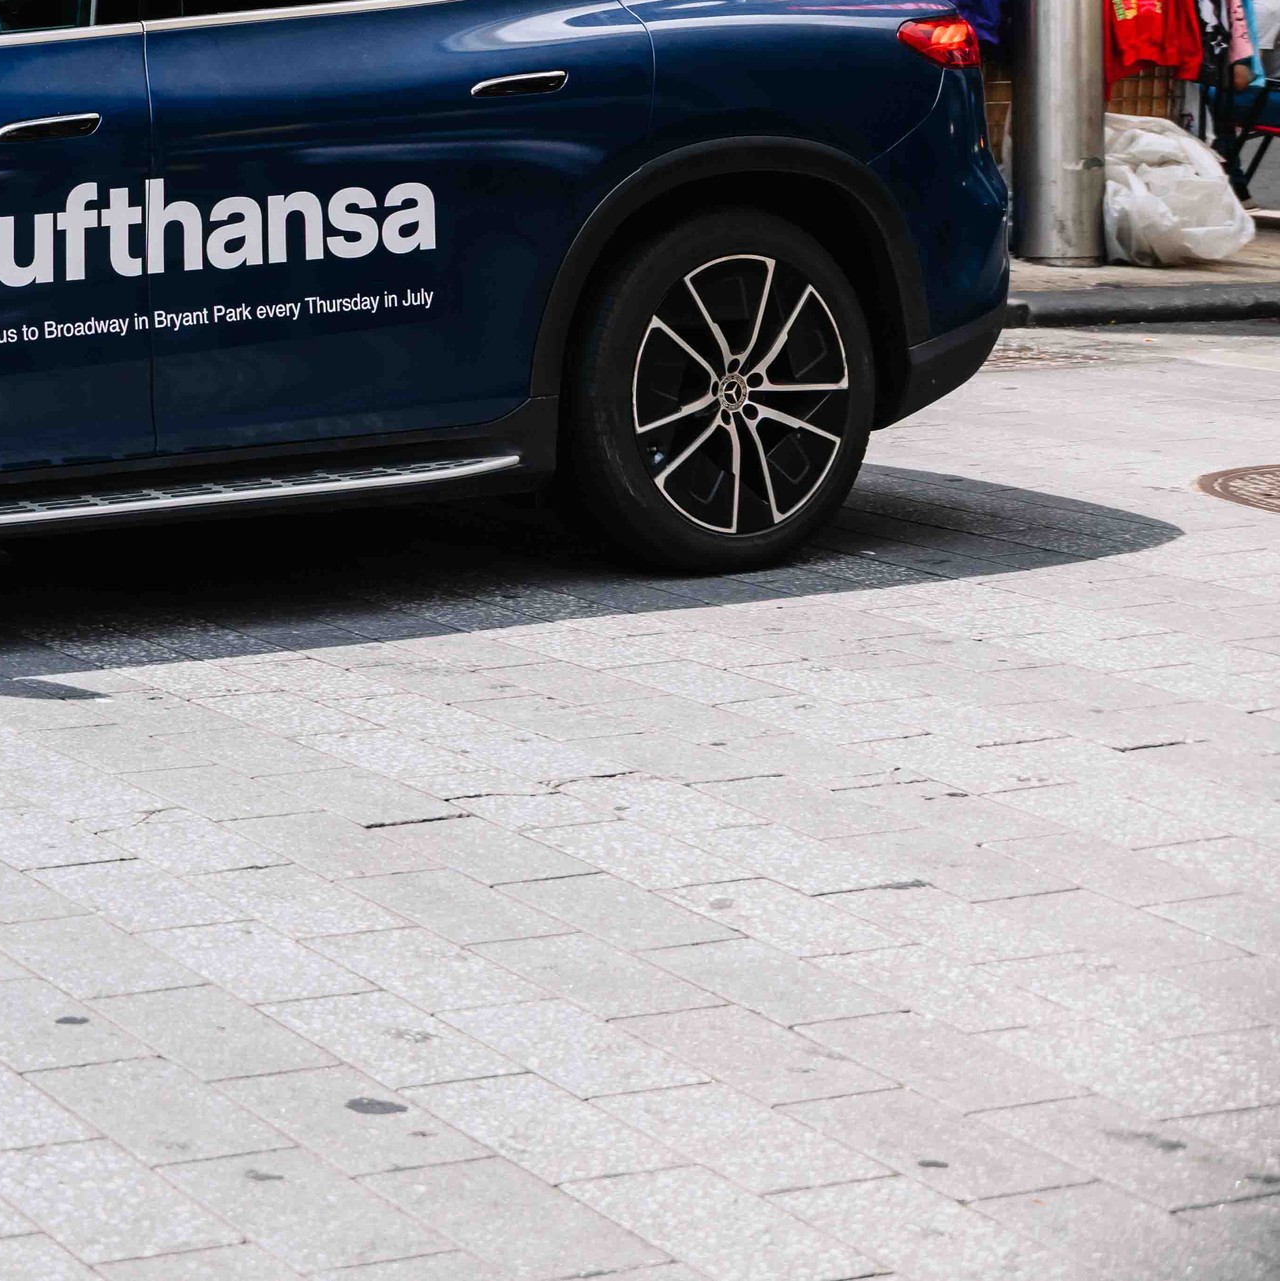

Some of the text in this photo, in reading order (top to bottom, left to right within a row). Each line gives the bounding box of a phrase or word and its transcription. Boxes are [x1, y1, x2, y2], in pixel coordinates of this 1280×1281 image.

[22, 324, 39, 342] to
[44, 317, 130, 339] Broadway
[134, 312, 149, 331] in
[154, 308, 209, 332] Bryant
[213, 303, 252, 323] Park
[256, 301, 301, 320] every
[305, 293, 380, 314] Thursday
[384, 291, 398, 308] in
[402, 288, 434, 308] July
